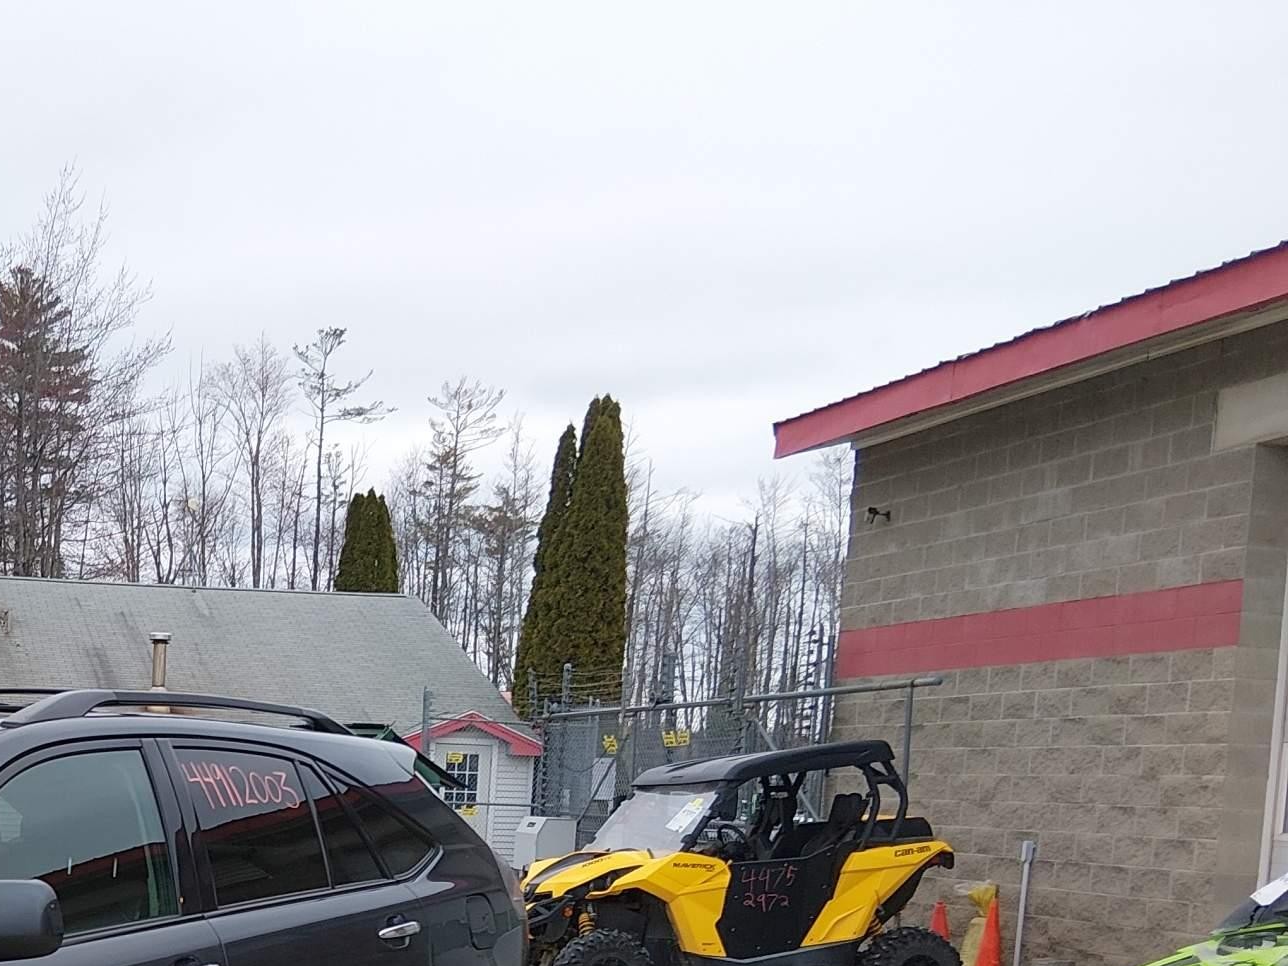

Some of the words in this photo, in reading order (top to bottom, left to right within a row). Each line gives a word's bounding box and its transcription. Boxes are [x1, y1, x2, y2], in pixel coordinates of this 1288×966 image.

[181, 761, 301, 809] 44912003
[741, 865, 799, 893] 4475
[743, 892, 790, 912] 2972
